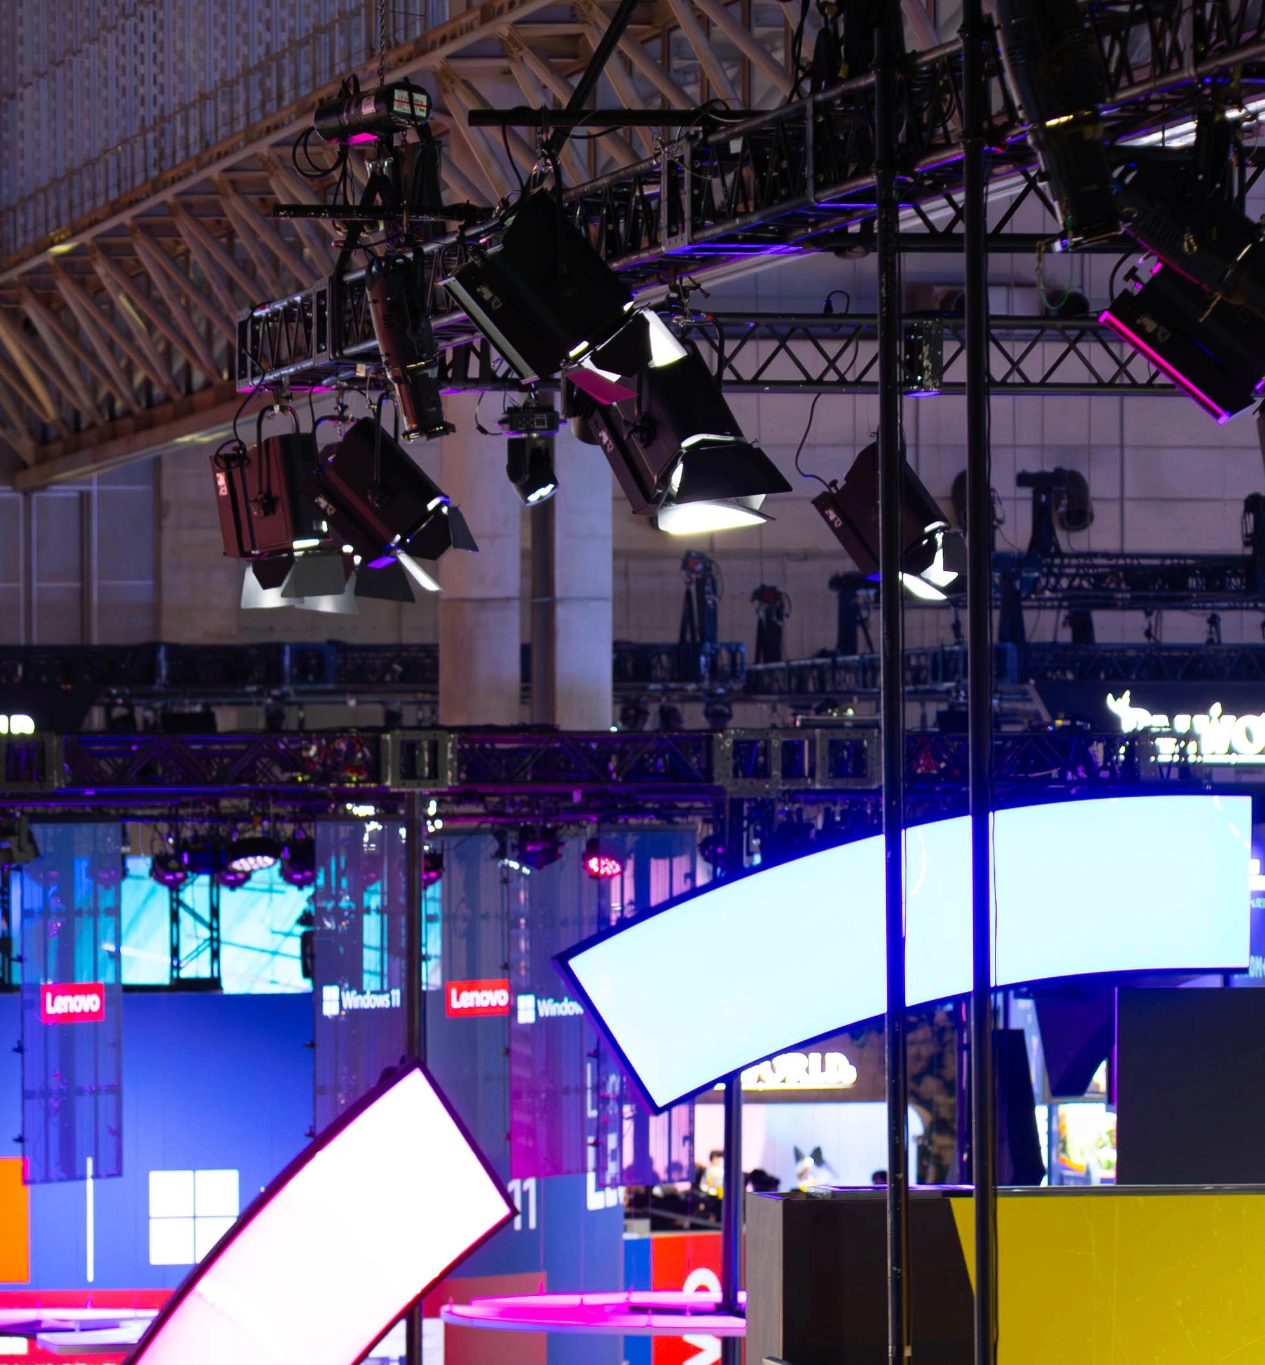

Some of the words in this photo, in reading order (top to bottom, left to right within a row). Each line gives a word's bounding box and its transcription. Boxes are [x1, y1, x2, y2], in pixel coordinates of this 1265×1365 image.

[46, 992, 100, 1014] Lenovo
[341, 992, 391, 1009] Windows
[391, 988, 401, 1007] 11
[451, 988, 508, 1009] Lenovo
[537, 995, 584, 1017] Windo
